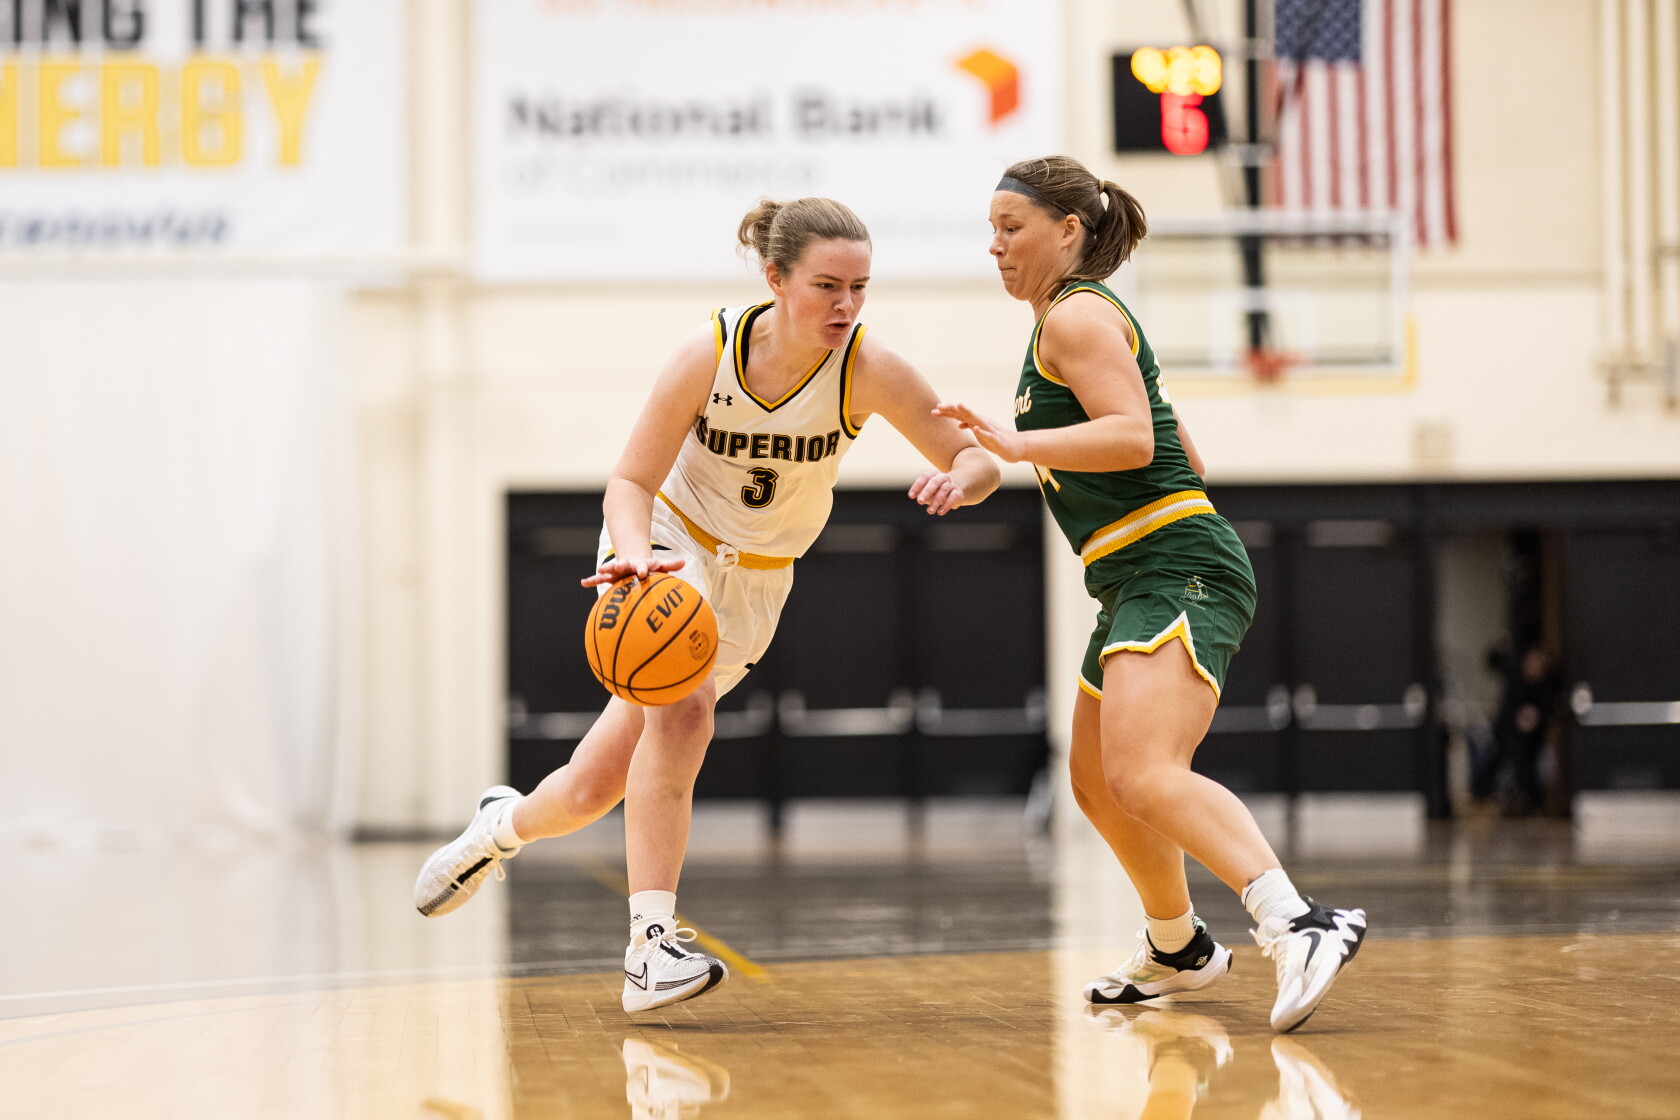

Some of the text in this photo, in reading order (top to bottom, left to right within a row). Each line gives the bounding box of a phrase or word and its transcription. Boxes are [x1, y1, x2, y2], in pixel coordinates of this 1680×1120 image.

[506, 89, 945, 139] National Bank
[694, 416, 841, 464] SUPERIOR
[740, 466, 780, 509] 3
[645, 587, 684, 634] EVO
